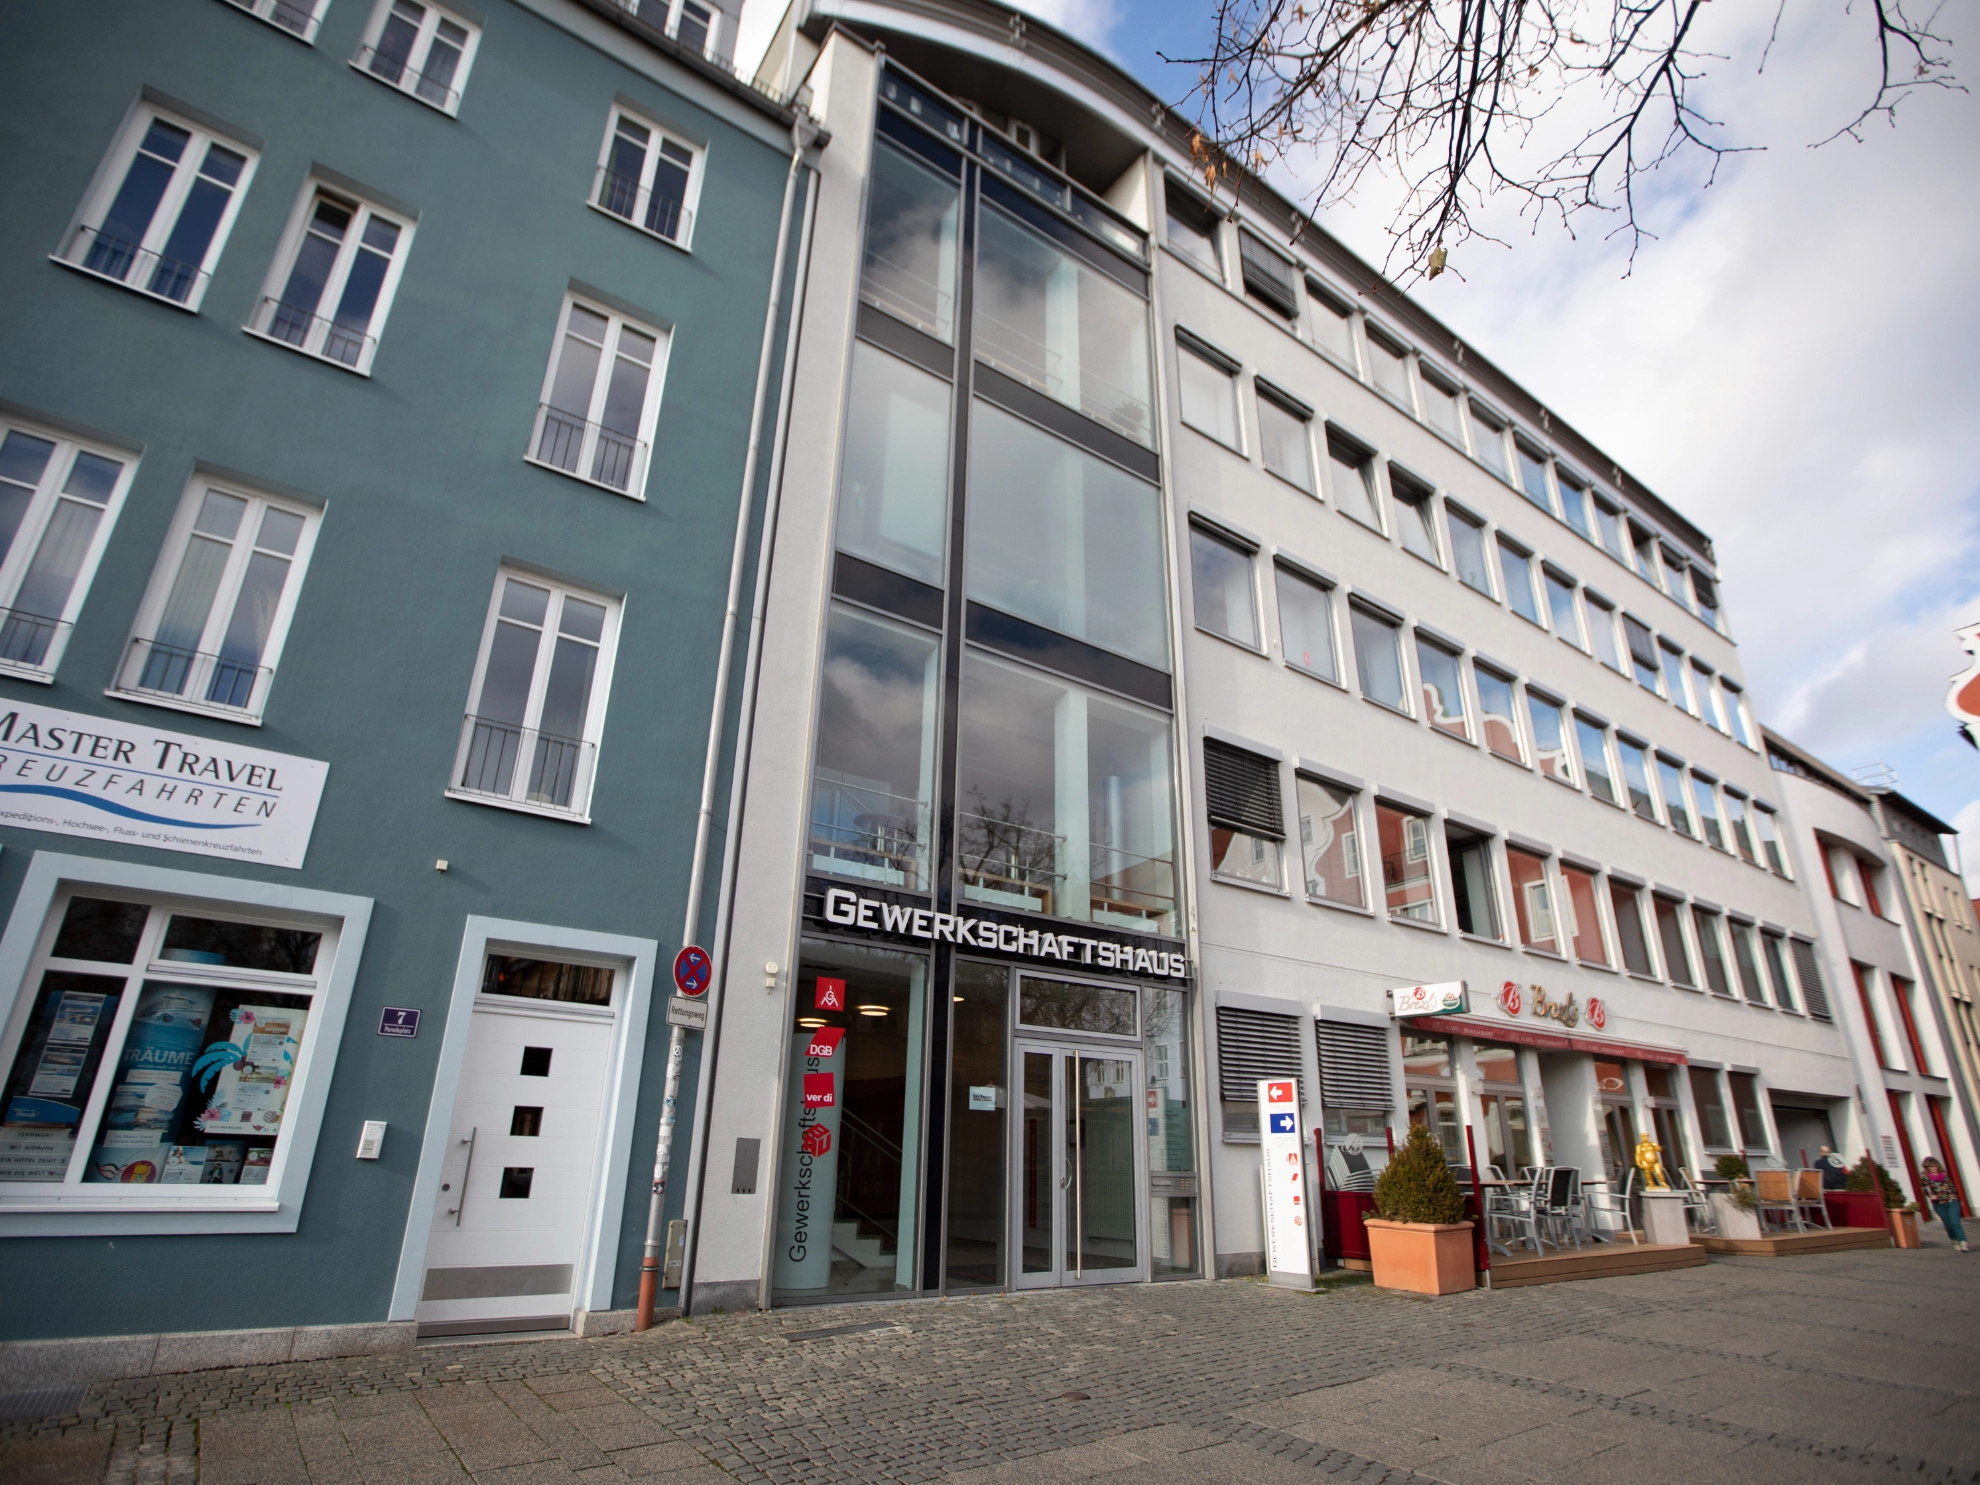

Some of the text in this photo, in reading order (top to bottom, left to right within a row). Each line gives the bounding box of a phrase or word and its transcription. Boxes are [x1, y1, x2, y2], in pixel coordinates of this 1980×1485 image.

[154, 739, 283, 791] TRAVEL
[113, 826, 139, 837] Fluss-
[142, 831, 161, 840] und
[163, 833, 263, 856] Schienenkreuzfahrten
[825, 887, 1186, 979] GEWERKSCHAFTSHAUS
[397, 1011, 407, 1024] 7
[671, 1005, 705, 1022] Rettungsweg
[123, 1045, 195, 1065] TRÄUME
[809, 1044, 833, 1057] DGB
